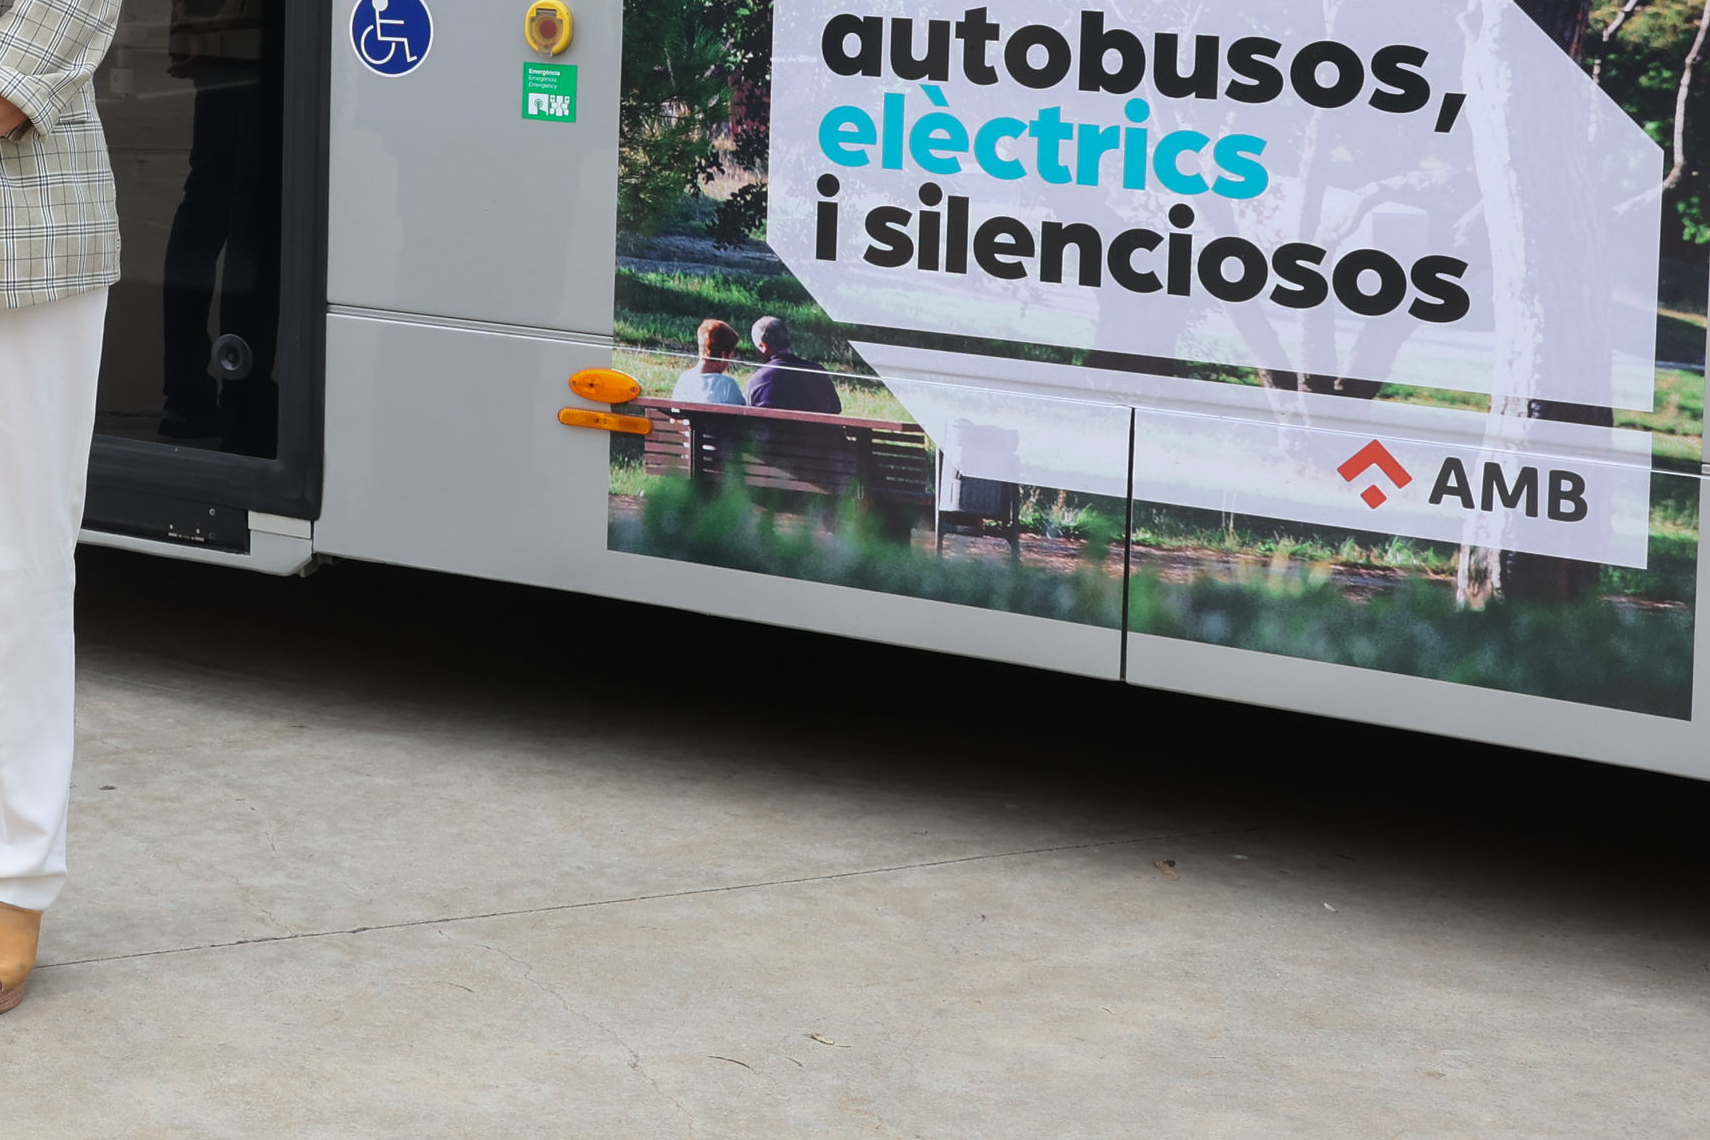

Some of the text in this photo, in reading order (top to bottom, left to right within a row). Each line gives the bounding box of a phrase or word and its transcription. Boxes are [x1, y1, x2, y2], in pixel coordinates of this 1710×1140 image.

[820, 6, 1467, 134] autobusos,
[818, 84, 1270, 200] elèctrics
[815, 173, 1471, 324] i silenciosos
[1428, 456, 1588, 523] AMB
